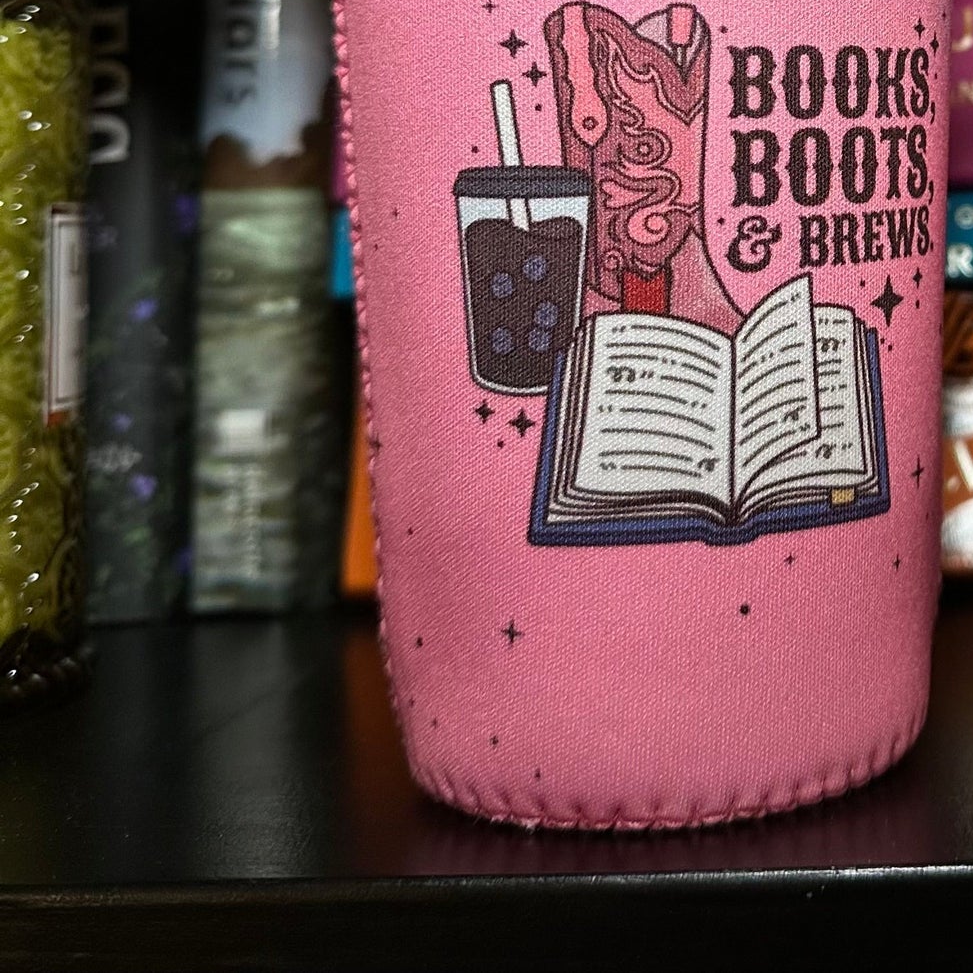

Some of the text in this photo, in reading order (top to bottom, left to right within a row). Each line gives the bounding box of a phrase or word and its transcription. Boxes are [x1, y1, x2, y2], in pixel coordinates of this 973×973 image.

[726, 44, 937, 124] BOOKS,
[730, 124, 935, 205] BOOTS,
[725, 205, 934, 273] & BREWS.
